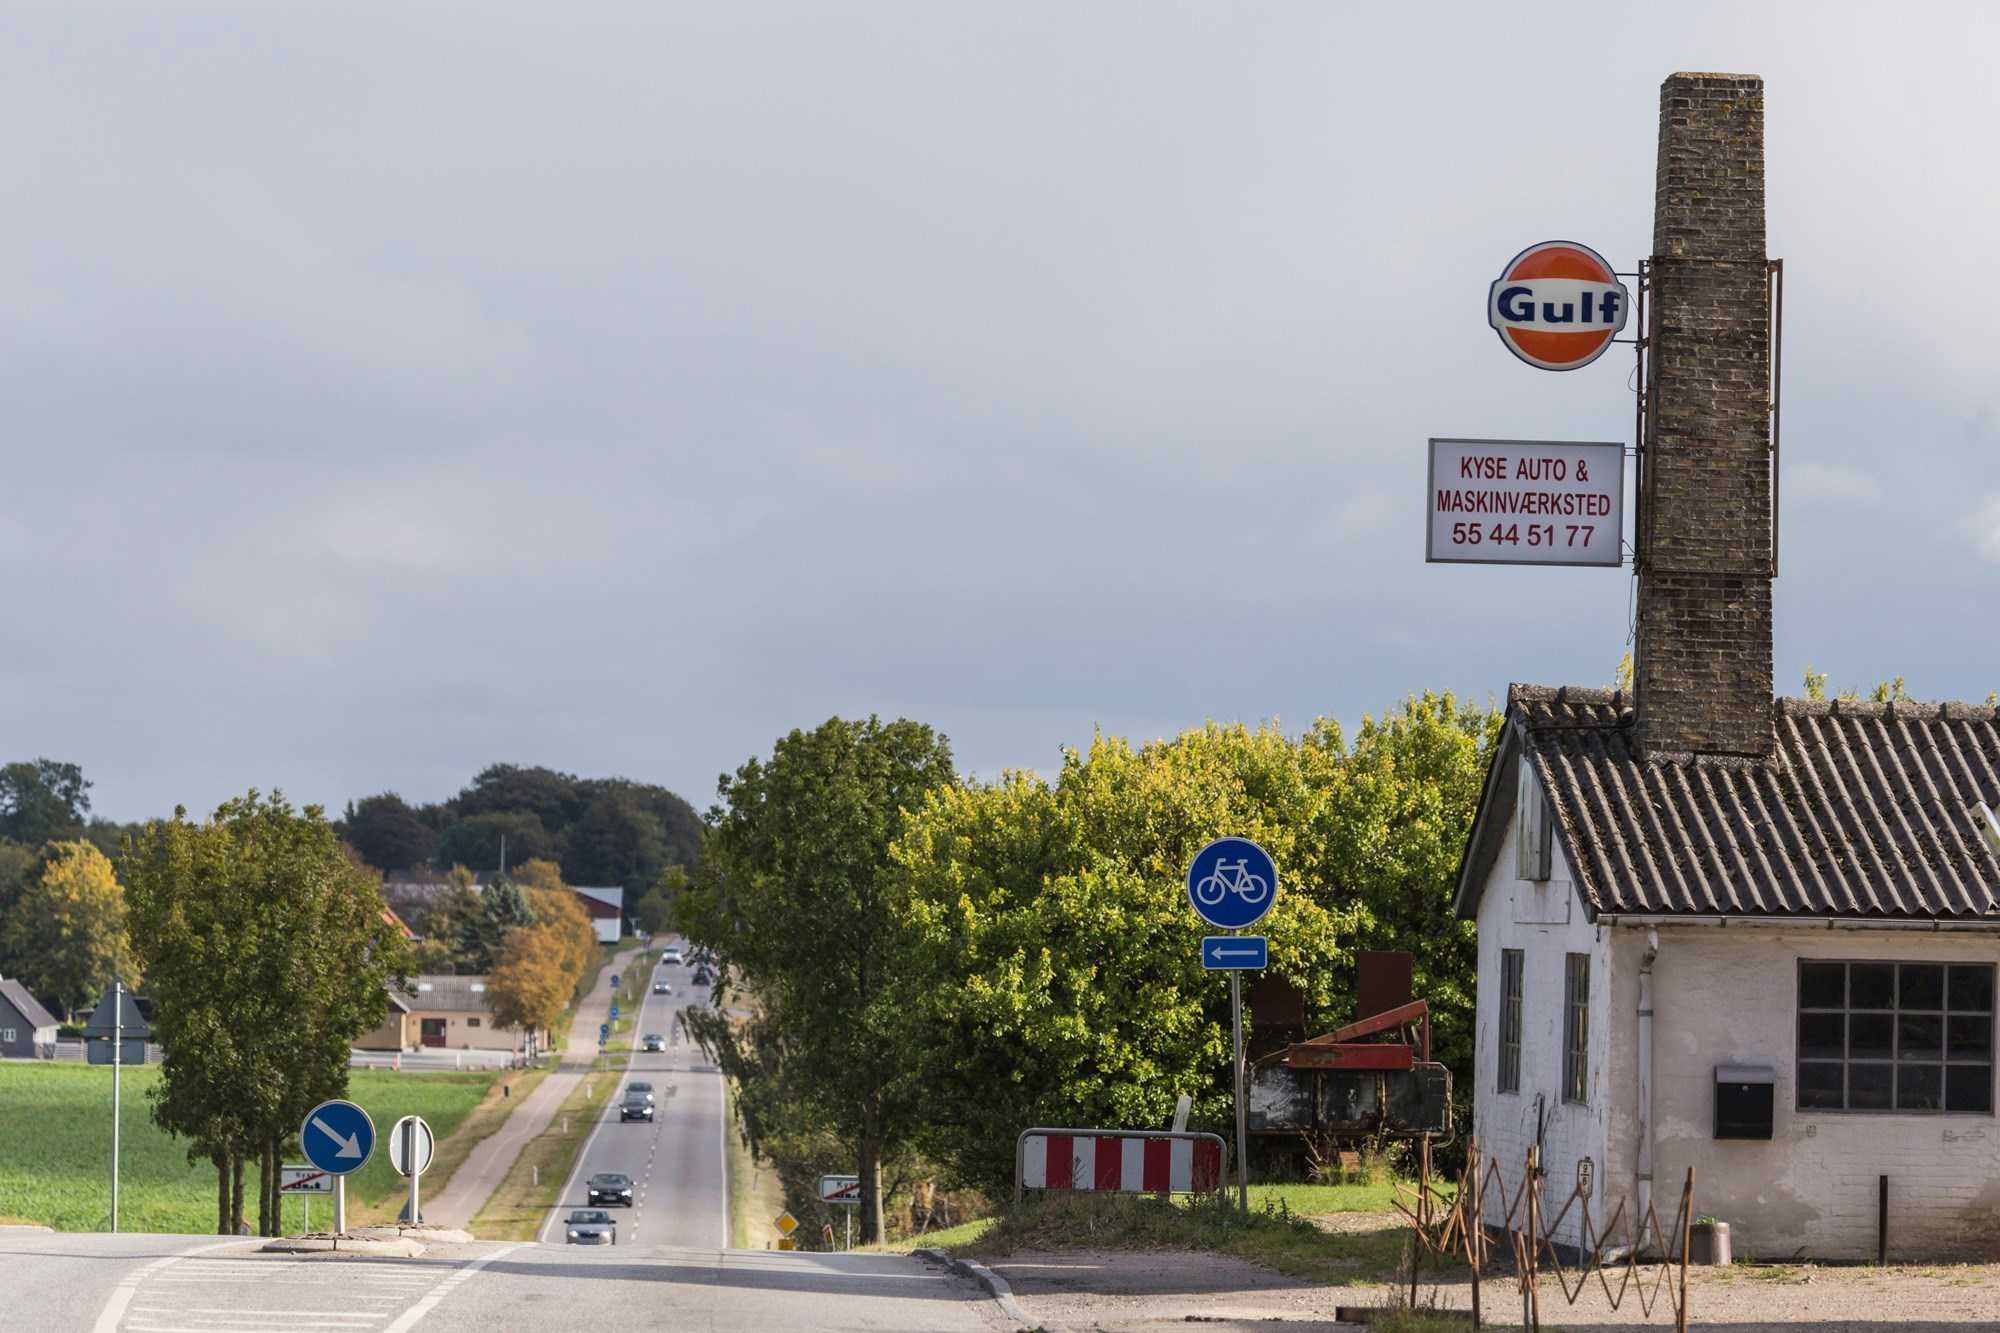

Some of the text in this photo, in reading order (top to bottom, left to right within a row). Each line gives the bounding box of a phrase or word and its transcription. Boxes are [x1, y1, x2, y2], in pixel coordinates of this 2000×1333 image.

[1497, 286, 1620, 323] Gulf
[1461, 456, 1589, 482] KYSE AUTO &
[1437, 490, 1611, 516] MASKINVÆRKSTED
[1452, 523, 1595, 547] 55 44 51 77
